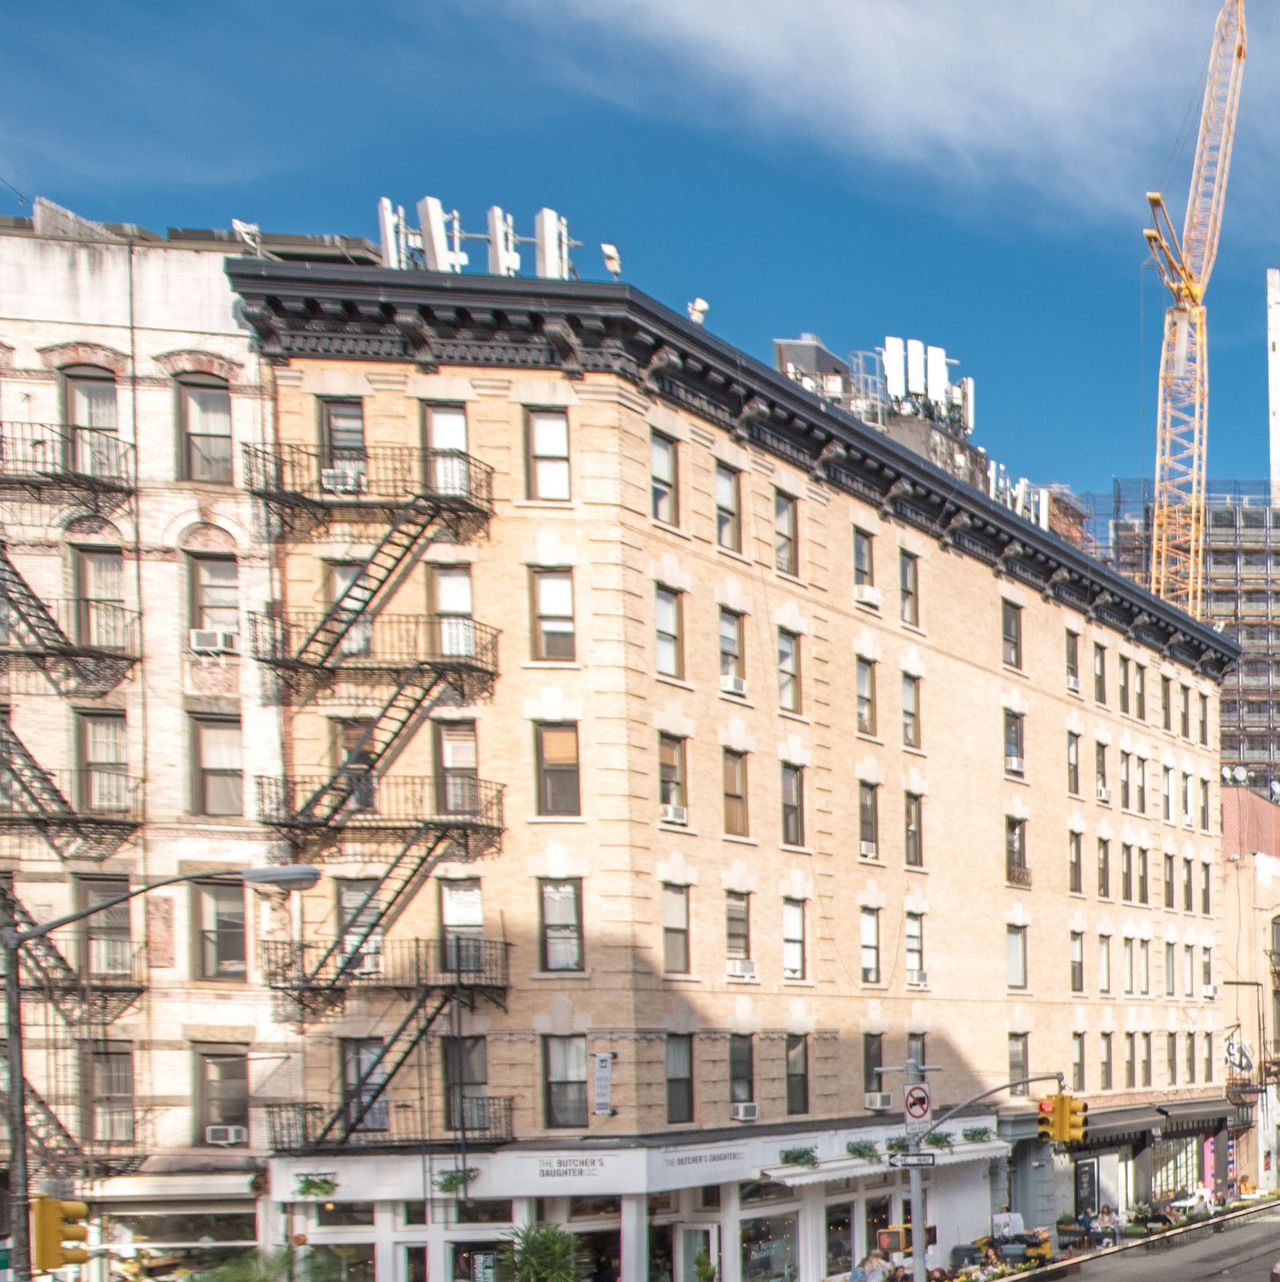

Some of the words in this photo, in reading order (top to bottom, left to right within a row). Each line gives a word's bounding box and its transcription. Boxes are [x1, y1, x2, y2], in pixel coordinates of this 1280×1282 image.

[539, 1159, 553, 1168] THE
[557, 1158, 604, 1168] BUTCHER'S
[539, 1168, 584, 1178] DAUGHTER
